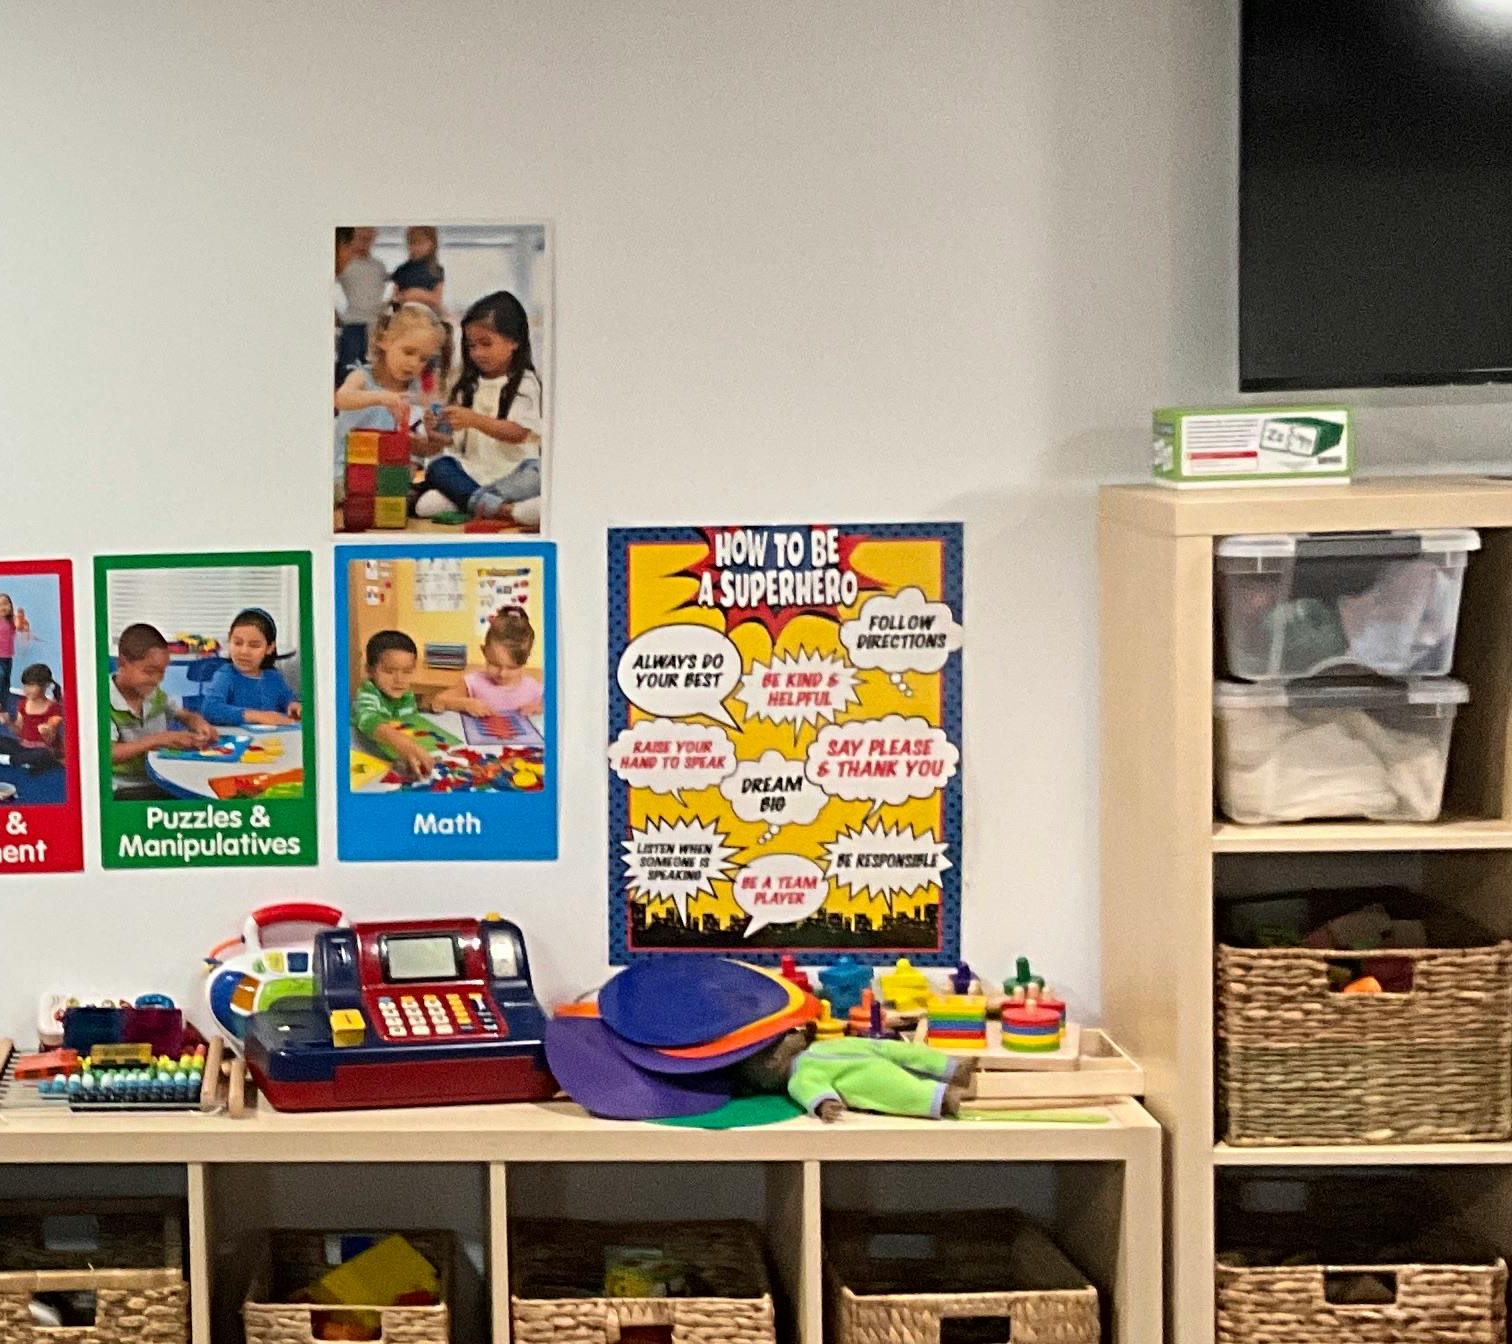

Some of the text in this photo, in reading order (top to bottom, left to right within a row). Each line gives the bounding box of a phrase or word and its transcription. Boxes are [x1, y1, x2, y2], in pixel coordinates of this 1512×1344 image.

[715, 528, 840, 567] HOW TO BE
[698, 567, 858, 607] A SUPERHERO
[869, 615, 936, 631] FOLLOW
[856, 633, 947, 649] DIRECTIONS
[632, 654, 724, 669] ALWAYS DO
[636, 672, 723, 688] YOUR BEST
[762, 672, 838, 688] BE KIND &
[767, 691, 832, 706] HELPFUL
[633, 740, 713, 753] RAISE YOUR
[827, 739, 934, 756] SAY PLEASE
[620, 756, 726, 769] HAND TO SPEAK
[817, 760, 945, 777] & THANK YOU
[742, 776, 803, 794] DREAM
[5, 811, 28, 837] &
[146, 805, 271, 831] Puzzles &
[413, 812, 481, 836] Math
[118, 833, 301, 862] Manipulatives
[637, 843, 713, 855] LISTEN WHEN
[639, 857, 710, 868] SOMEONE IS
[837, 853, 937, 868] BE RESPONSIBLE
[647, 870, 701, 881] SPEAKING
[741, 876, 817, 889] BE A TEAM
[754, 892, 805, 905] PLAYER
